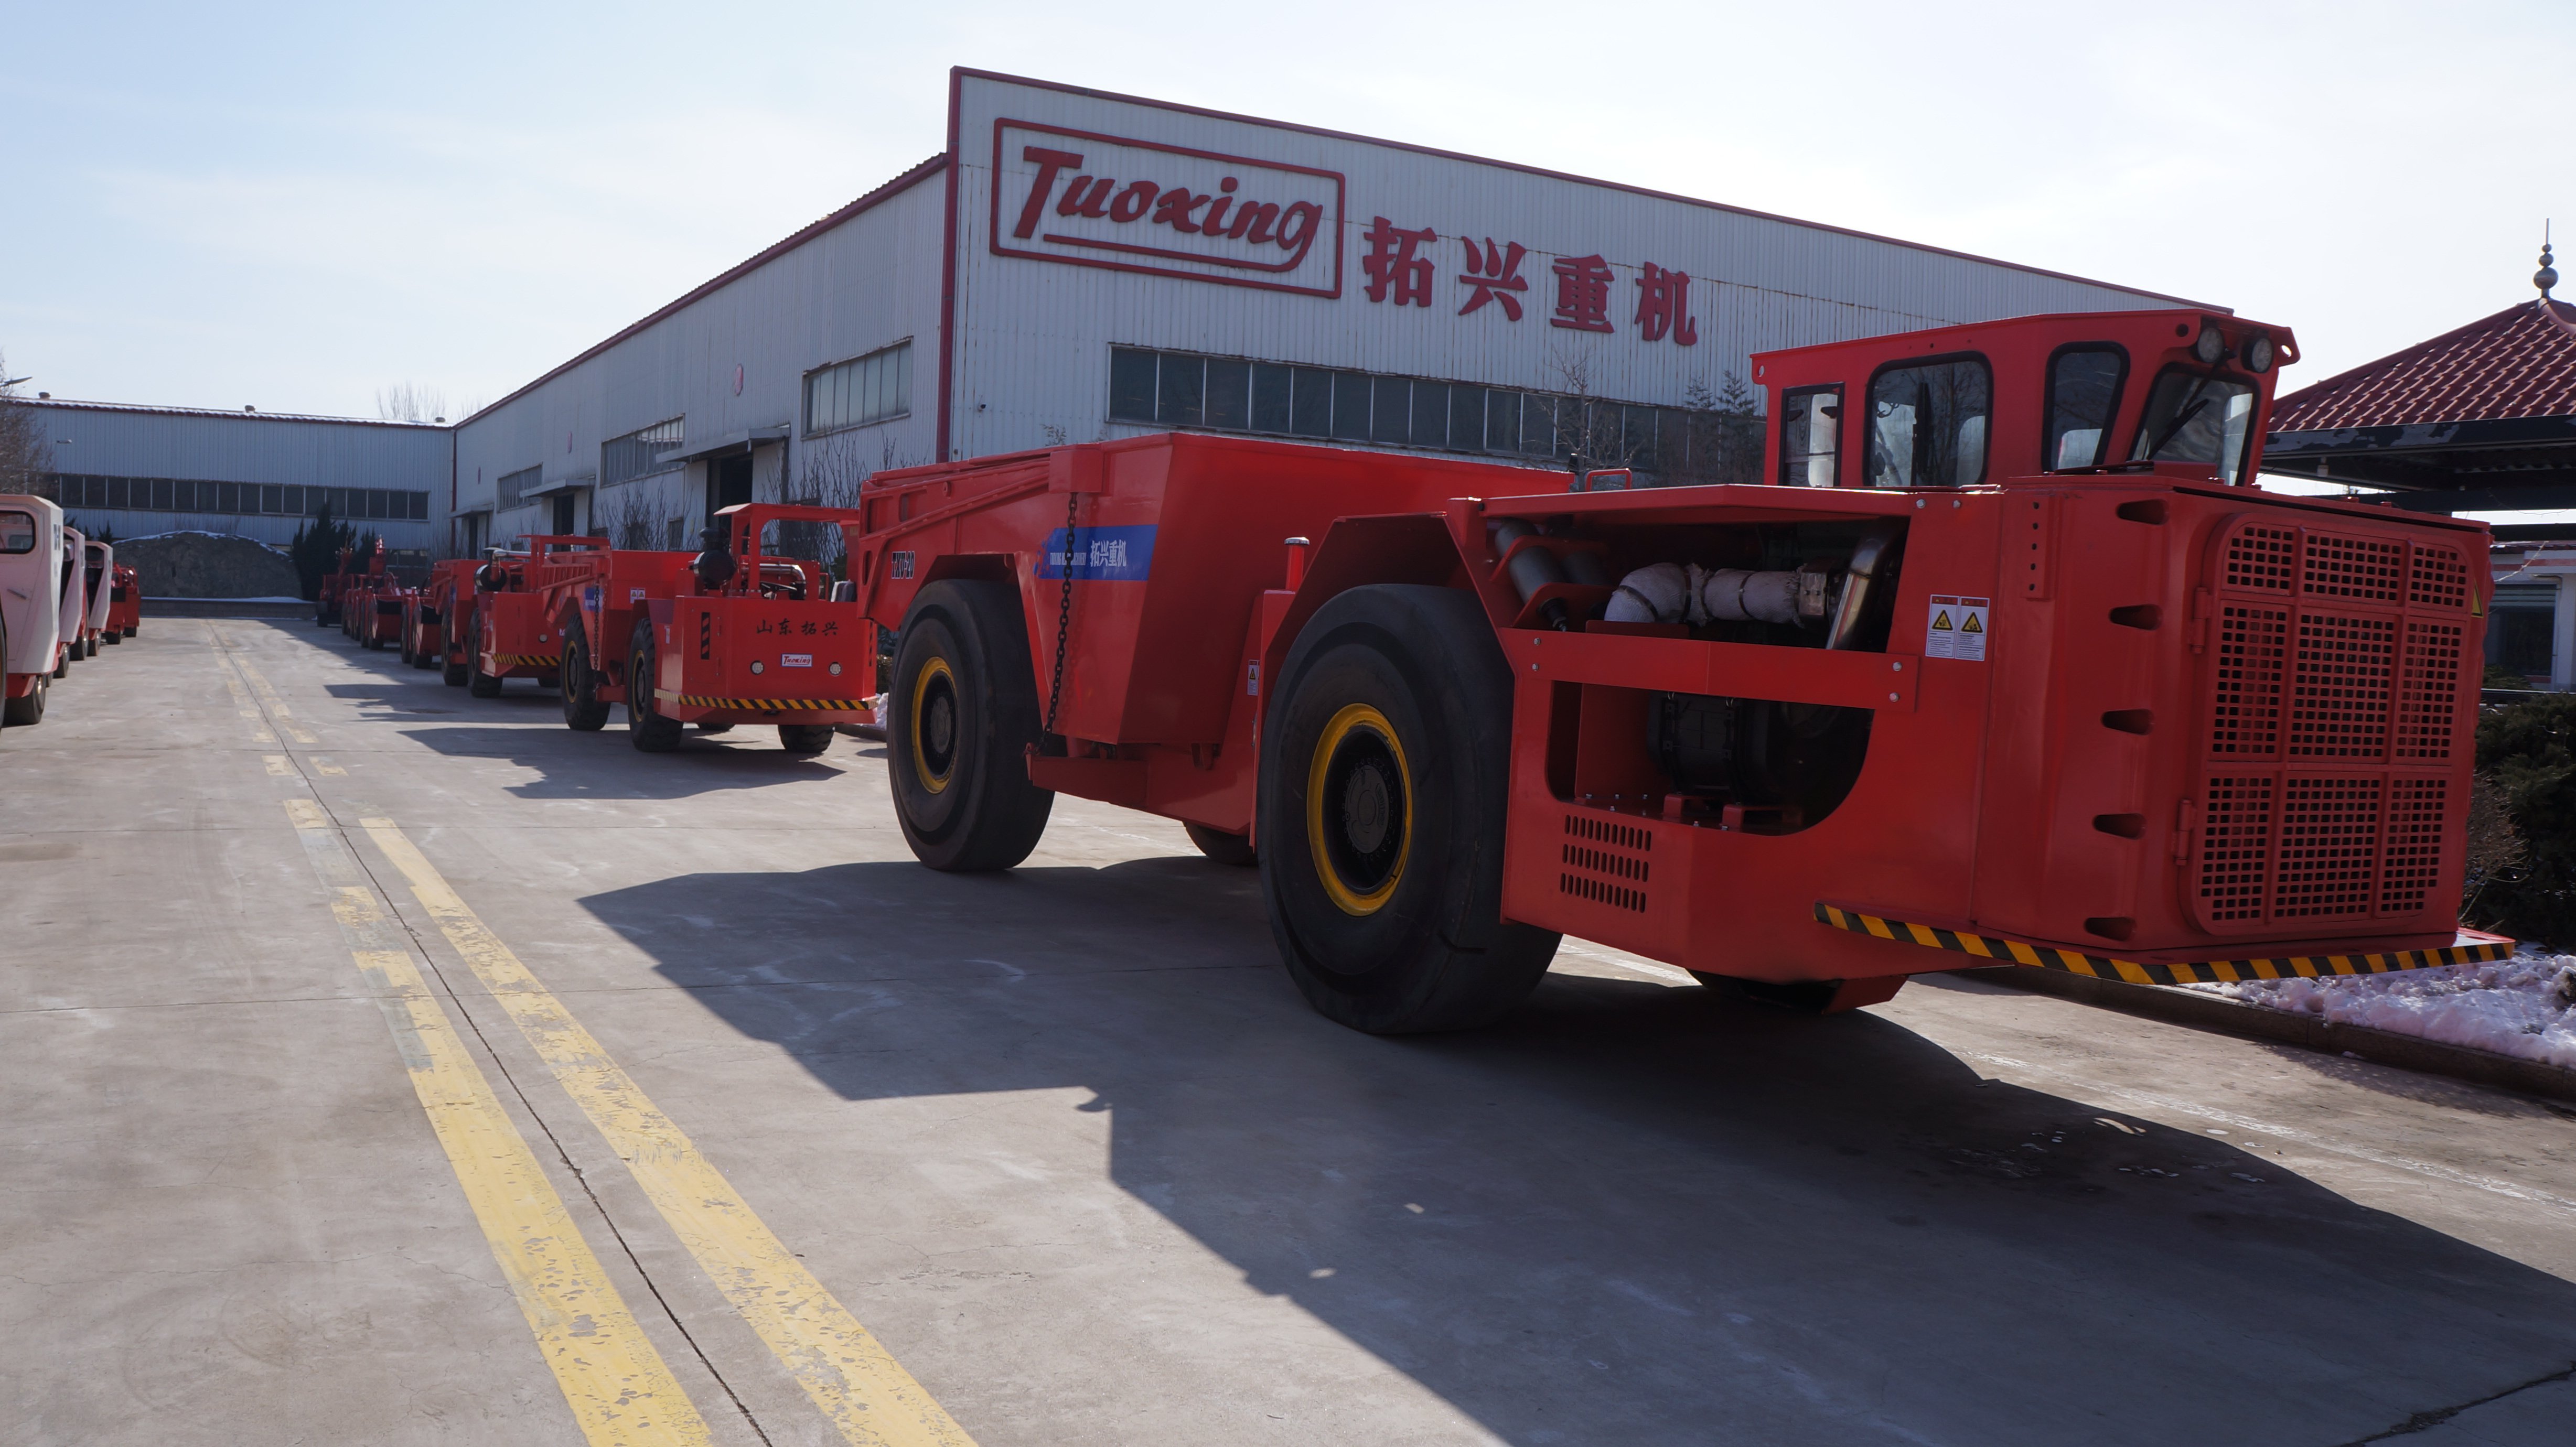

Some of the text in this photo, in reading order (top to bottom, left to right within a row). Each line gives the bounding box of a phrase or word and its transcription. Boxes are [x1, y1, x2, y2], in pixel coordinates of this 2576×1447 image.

[1013, 146, 1324, 273] Tuoxing
[1363, 215, 1698, 346] 拓兴重机
[1090, 539, 1127, 567] 拓兴重机
